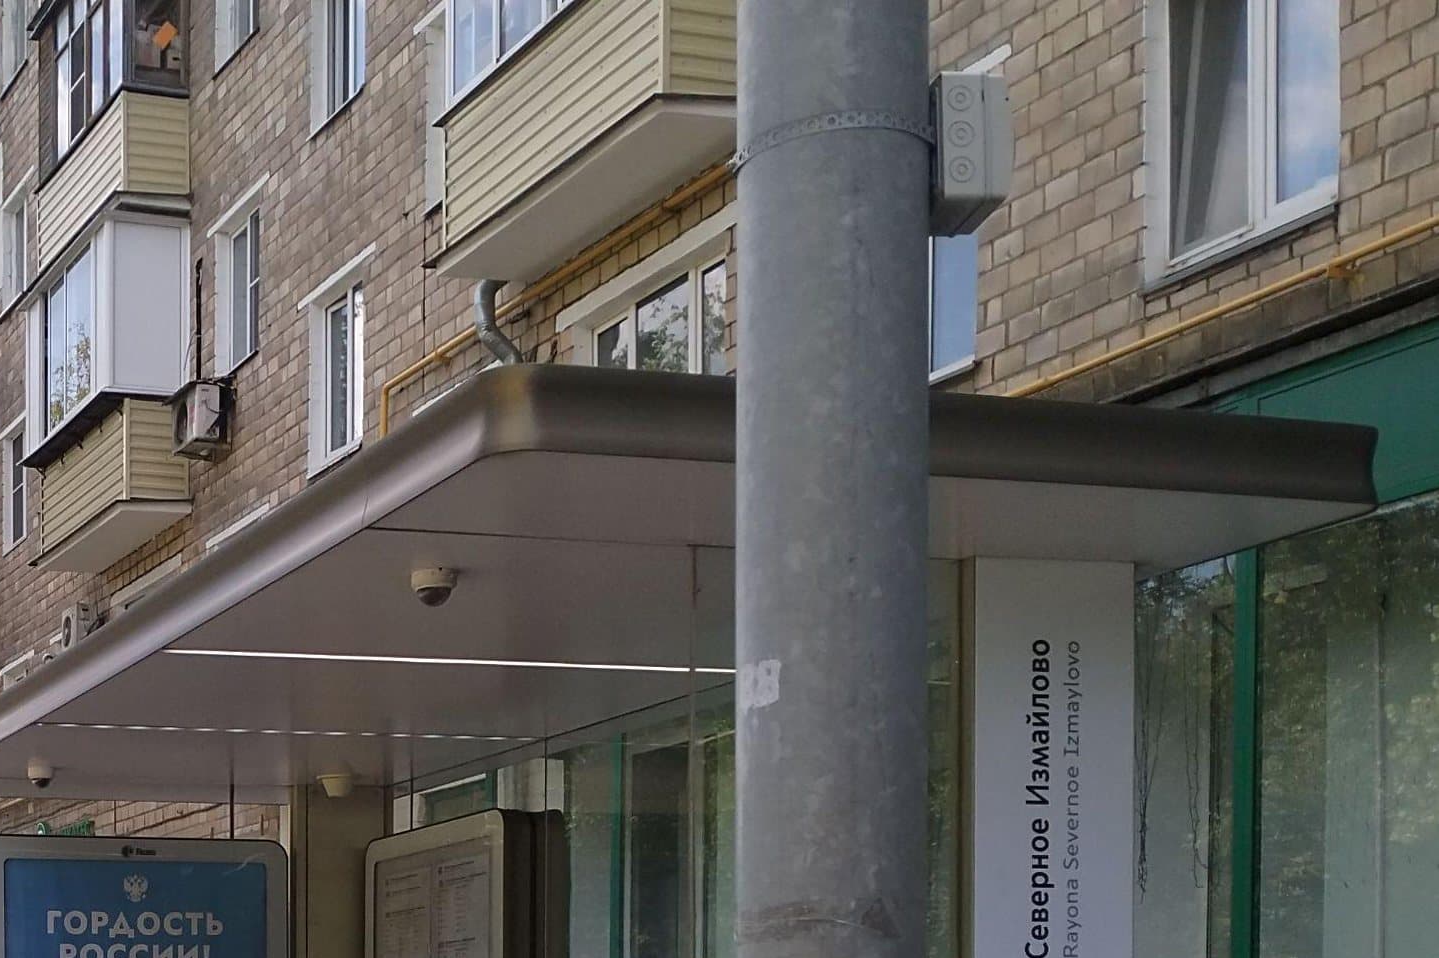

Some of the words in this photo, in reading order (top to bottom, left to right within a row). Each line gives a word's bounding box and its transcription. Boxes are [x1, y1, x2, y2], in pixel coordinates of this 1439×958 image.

[1025, 639, 1051, 805] Измайлово
[1062, 640, 1083, 757] Izmaylovo
[1062, 766, 1080, 870] Severnoe
[46, 910, 224, 938] ГОРДОСТЬ
[1062, 878, 1083, 958] Rayona
